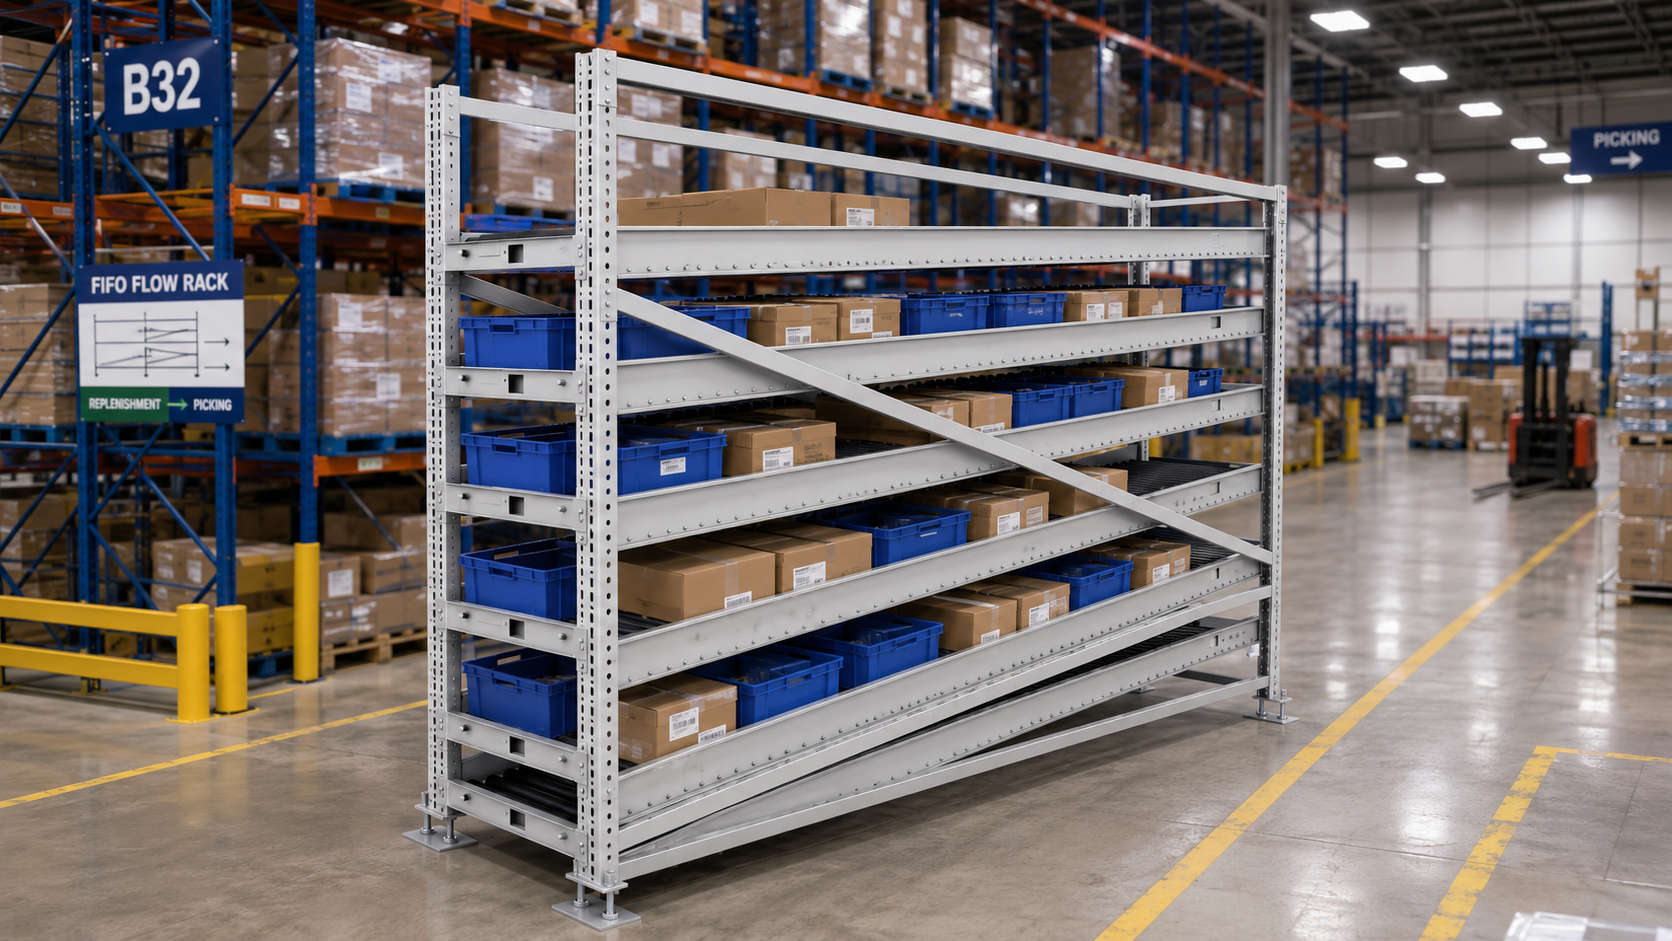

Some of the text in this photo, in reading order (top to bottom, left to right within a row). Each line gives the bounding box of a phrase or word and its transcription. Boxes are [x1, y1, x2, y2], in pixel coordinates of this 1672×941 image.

[123, 57, 201, 116] B32
[1593, 128, 1661, 149] PICKING
[91, 272, 229, 294] FIFO FLOW RACK
[88, 397, 232, 411] REPLENISHMENT PICKING
